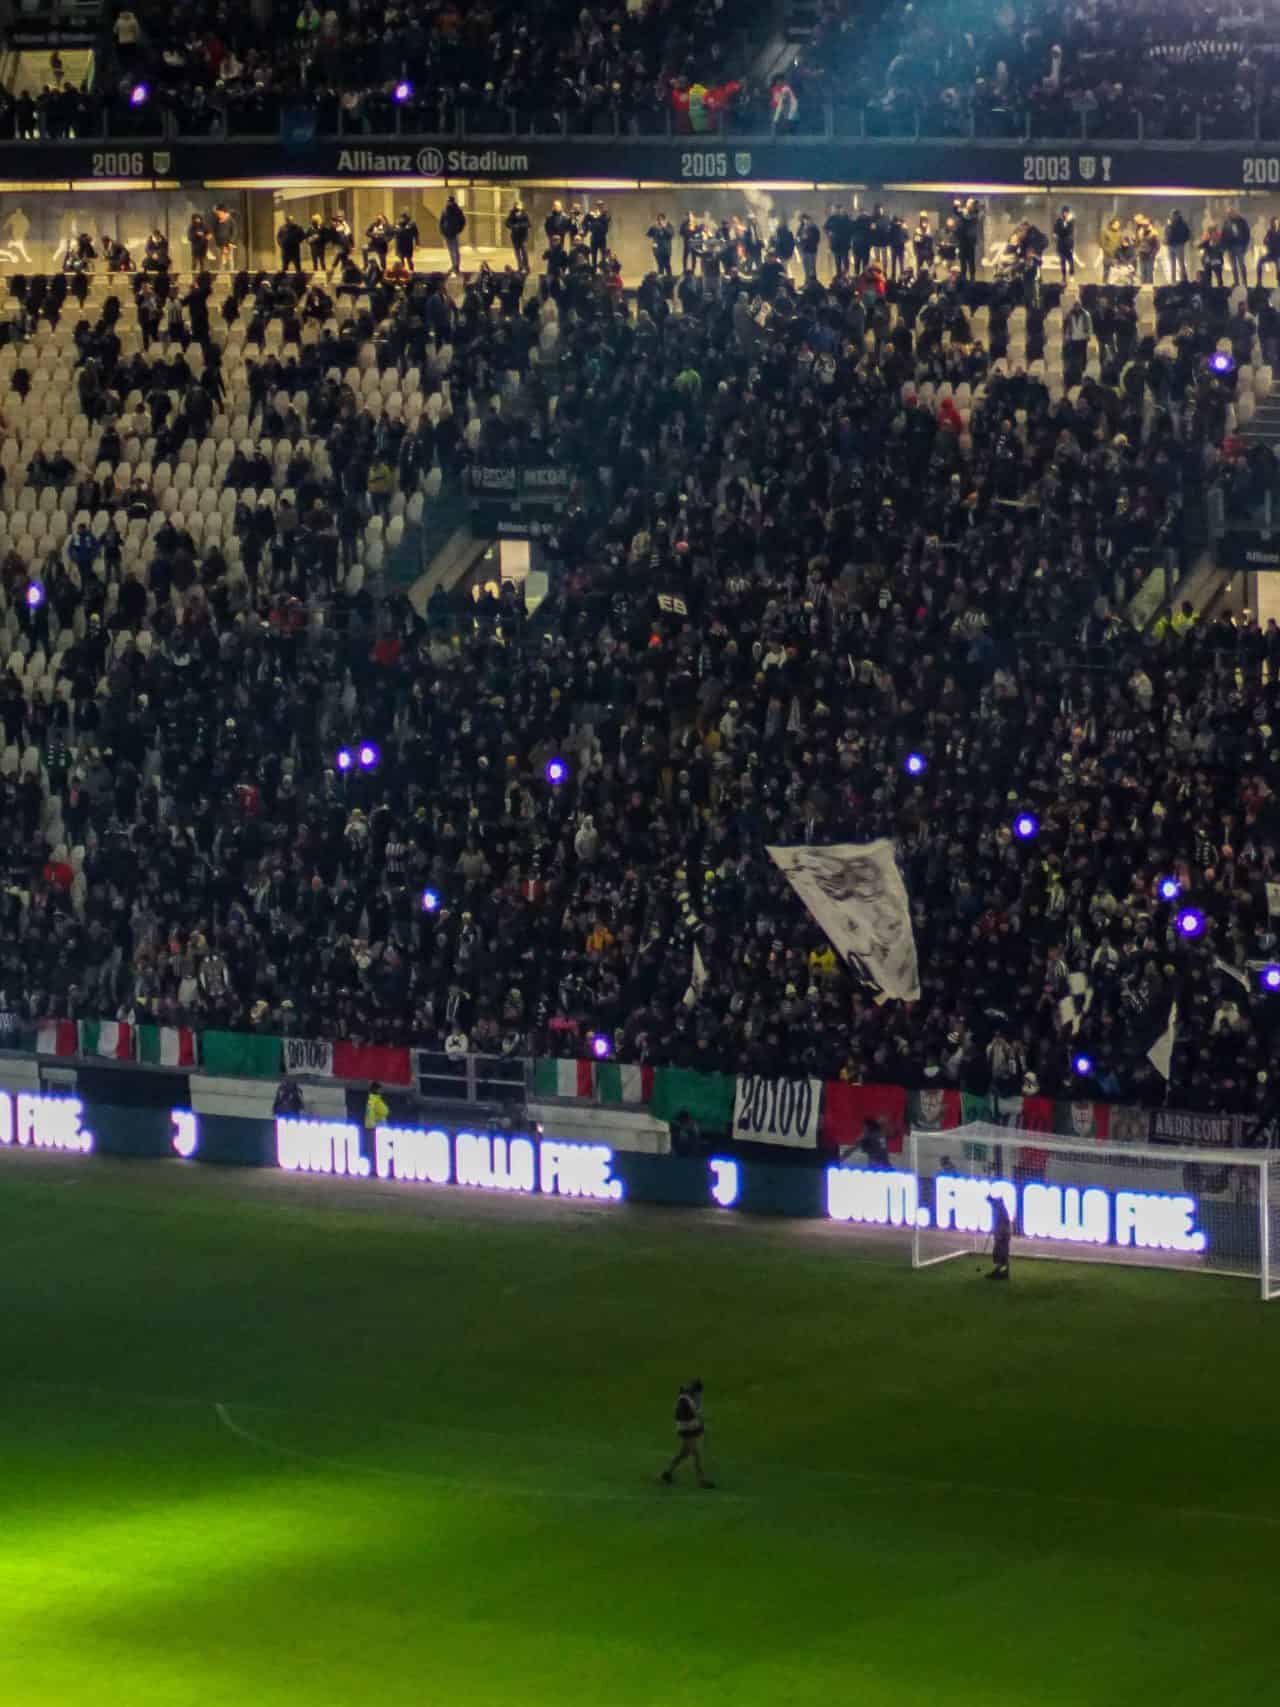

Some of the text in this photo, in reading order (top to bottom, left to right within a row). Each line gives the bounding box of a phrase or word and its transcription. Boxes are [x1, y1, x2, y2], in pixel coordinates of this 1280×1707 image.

[92, 153, 143, 176] 2006
[337, 151, 528, 171] Allianz Stadium
[681, 154, 727, 176] 2005
[1024, 156, 1070, 180] 2003
[738, 1076, 813, 1136] 20100
[376, 1127, 449, 1183] FINO
[456, 1133, 534, 1190] ALLA
[541, 1142, 621, 1199] FINE.
[1023, 1185, 1109, 1242] ALLA
[1117, 1193, 1205, 1251] FINE.
